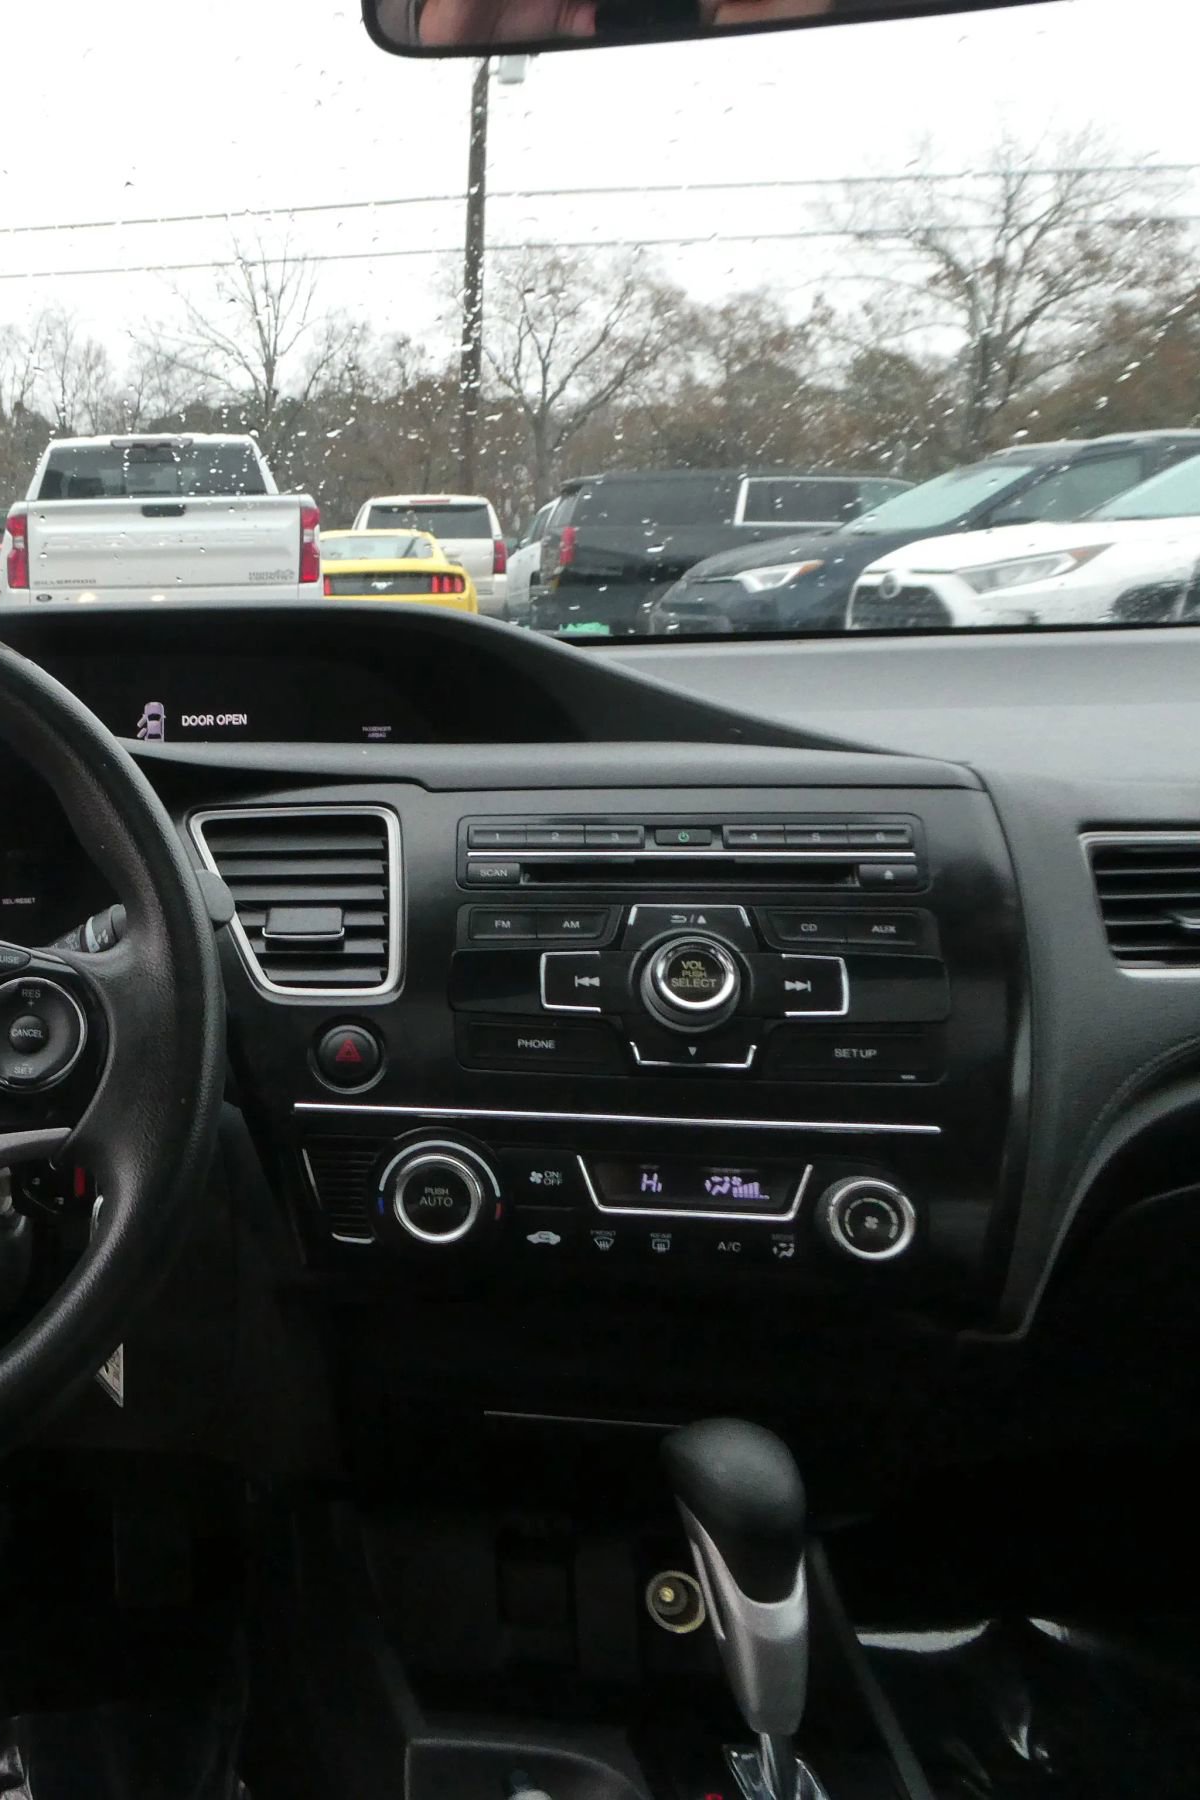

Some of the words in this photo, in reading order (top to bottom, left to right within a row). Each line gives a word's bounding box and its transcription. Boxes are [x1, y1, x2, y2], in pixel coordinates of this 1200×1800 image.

[181, 714, 214, 727] DOOR
[216, 714, 247, 726] OPEN
[551, 832, 559, 841] 2
[610, 832, 619, 841] 3
[749, 832, 758, 841] 4
[812, 832, 820, 842] 5
[875, 832, 885, 842] 6
[479, 868, 508, 878] SCAN
[494, 919, 512, 929] FM
[561, 920, 580, 929] AM
[800, 923, 818, 932] CD
[871, 924, 897, 933] AUX
[681, 960, 706, 971] VOL
[671, 977, 717, 988] SELECT
[21, 988, 41, 999] RES
[10, 1030, 43, 1039] CANCEL
[517, 1038, 556, 1049] PHONE
[543, 1177, 563, 1186] OFF
[424, 1186, 449, 1195] PUSH
[419, 1194, 453, 1208] AUTO
[716, 1240, 742, 1252] A/C
